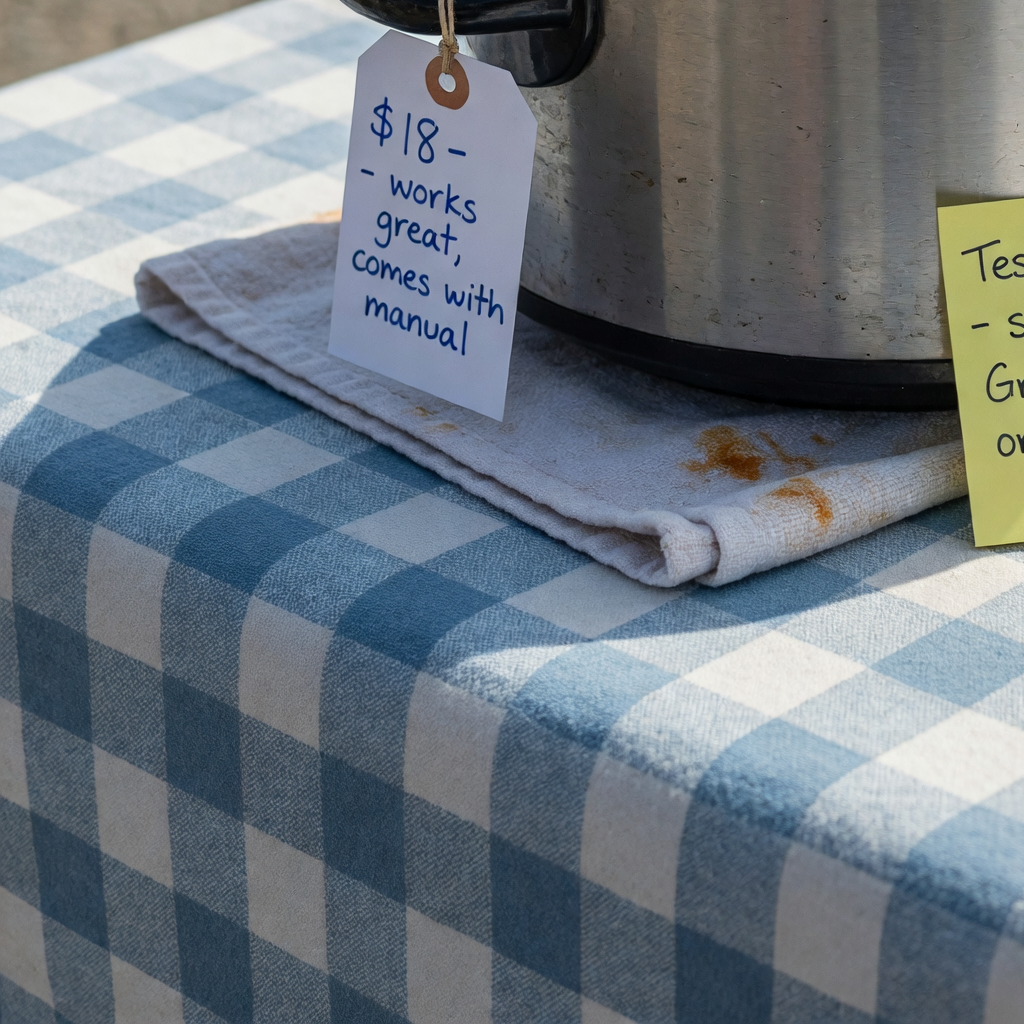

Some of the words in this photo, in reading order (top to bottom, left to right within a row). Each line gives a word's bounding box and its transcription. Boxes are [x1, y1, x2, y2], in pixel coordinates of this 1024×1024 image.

[389, 173, 477, 224] works
[373, 210, 461, 268] great,
[351, 249, 431, 297] comes
[444, 283, 505, 326] with
[364, 294, 469, 357] manual
